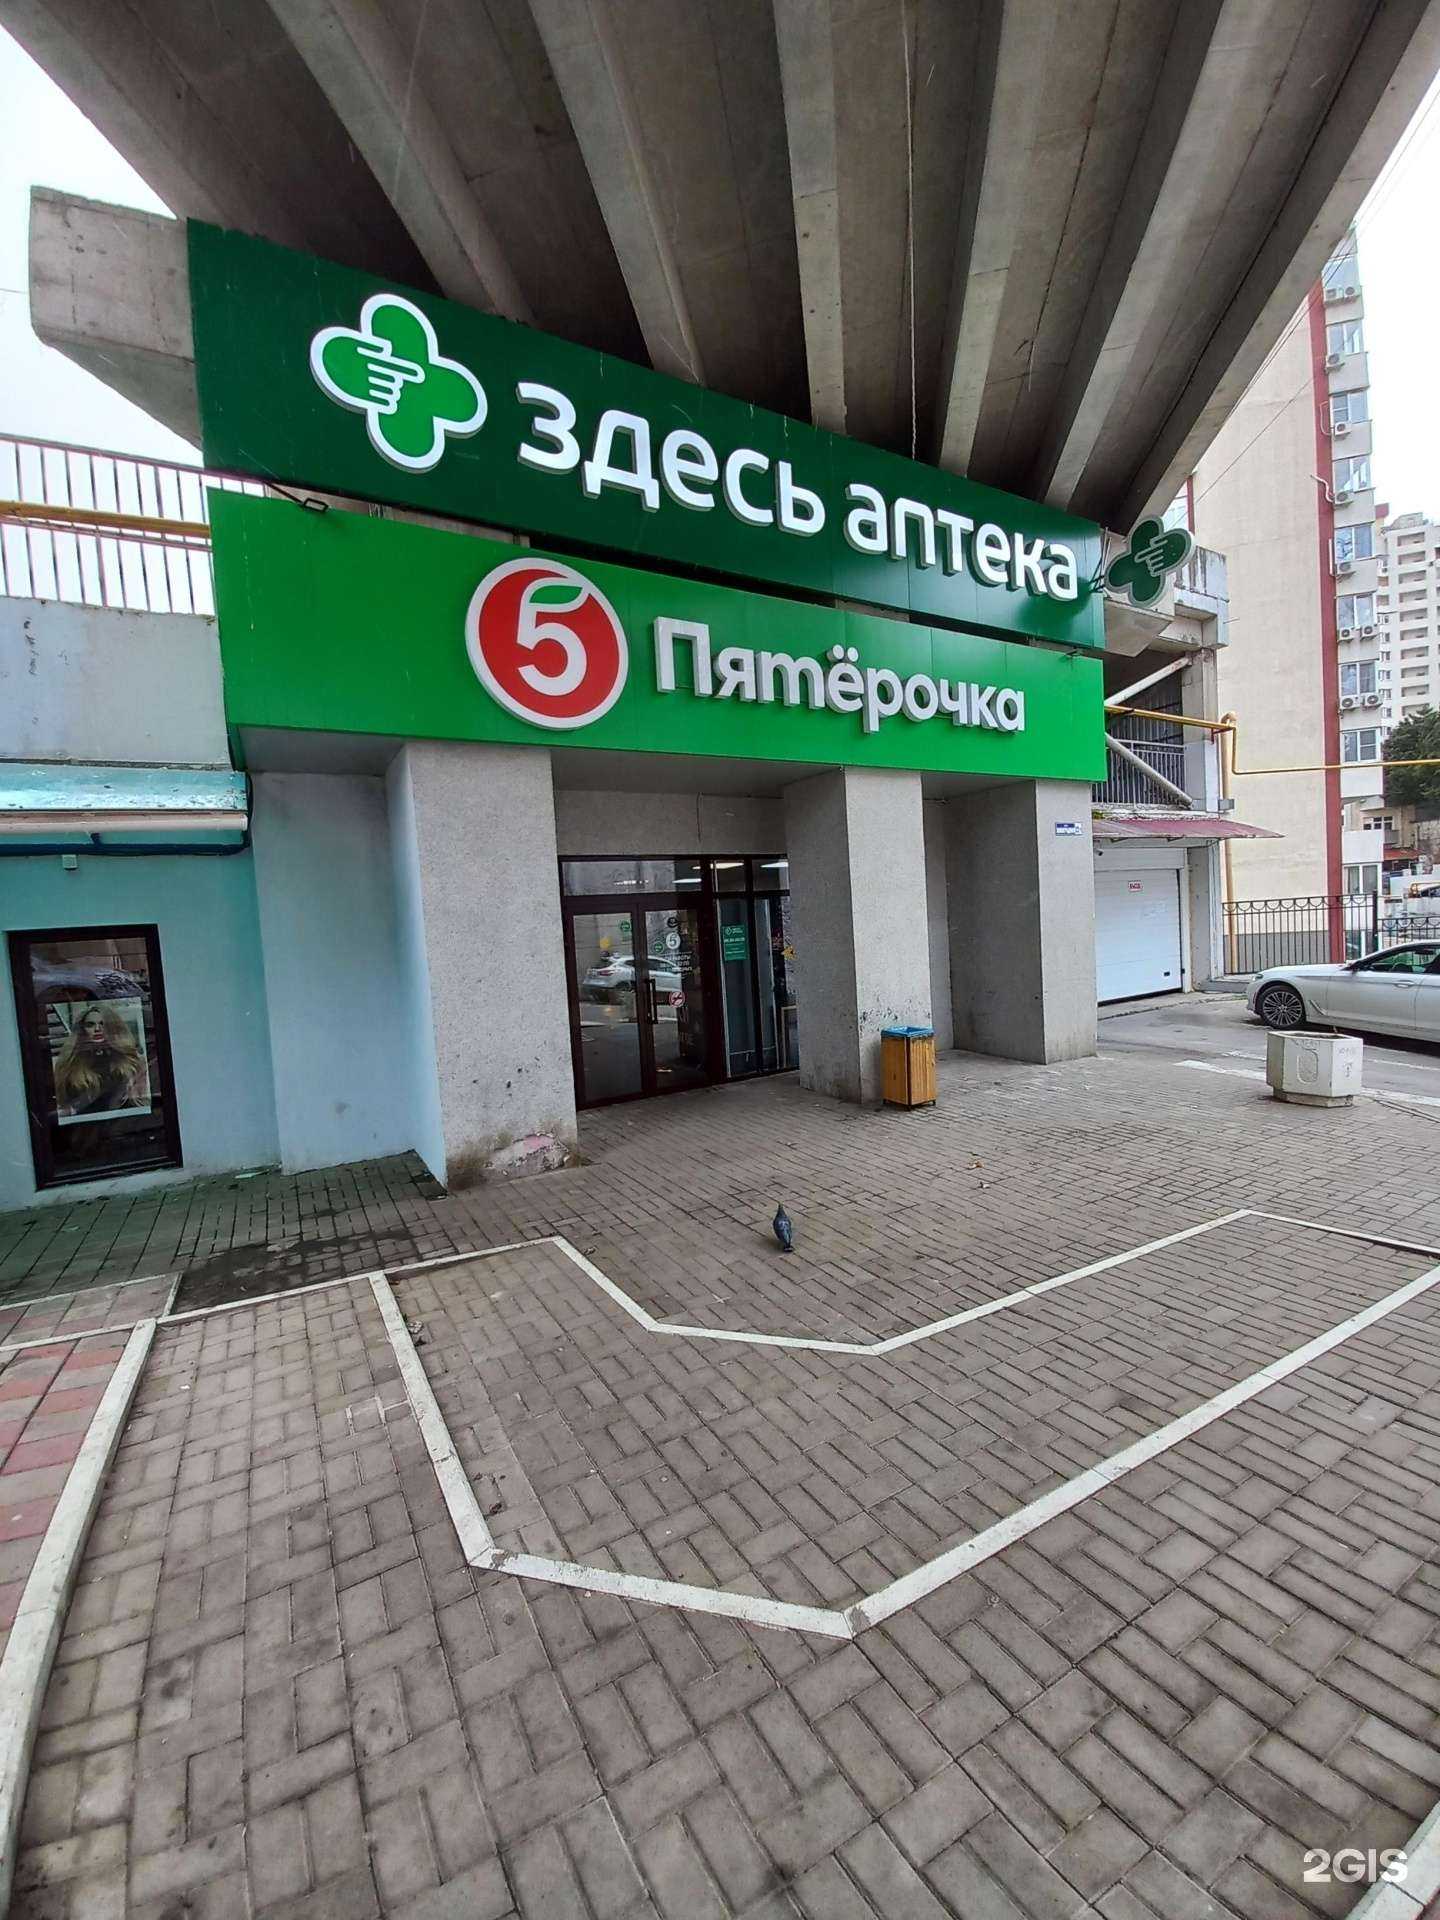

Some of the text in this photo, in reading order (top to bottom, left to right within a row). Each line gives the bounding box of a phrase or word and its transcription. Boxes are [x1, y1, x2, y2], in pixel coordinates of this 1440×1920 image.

[517, 381, 1078, 601] здесь аптека
[516, 577, 590, 697] 5
[654, 616, 1025, 733] Пятёрочка
